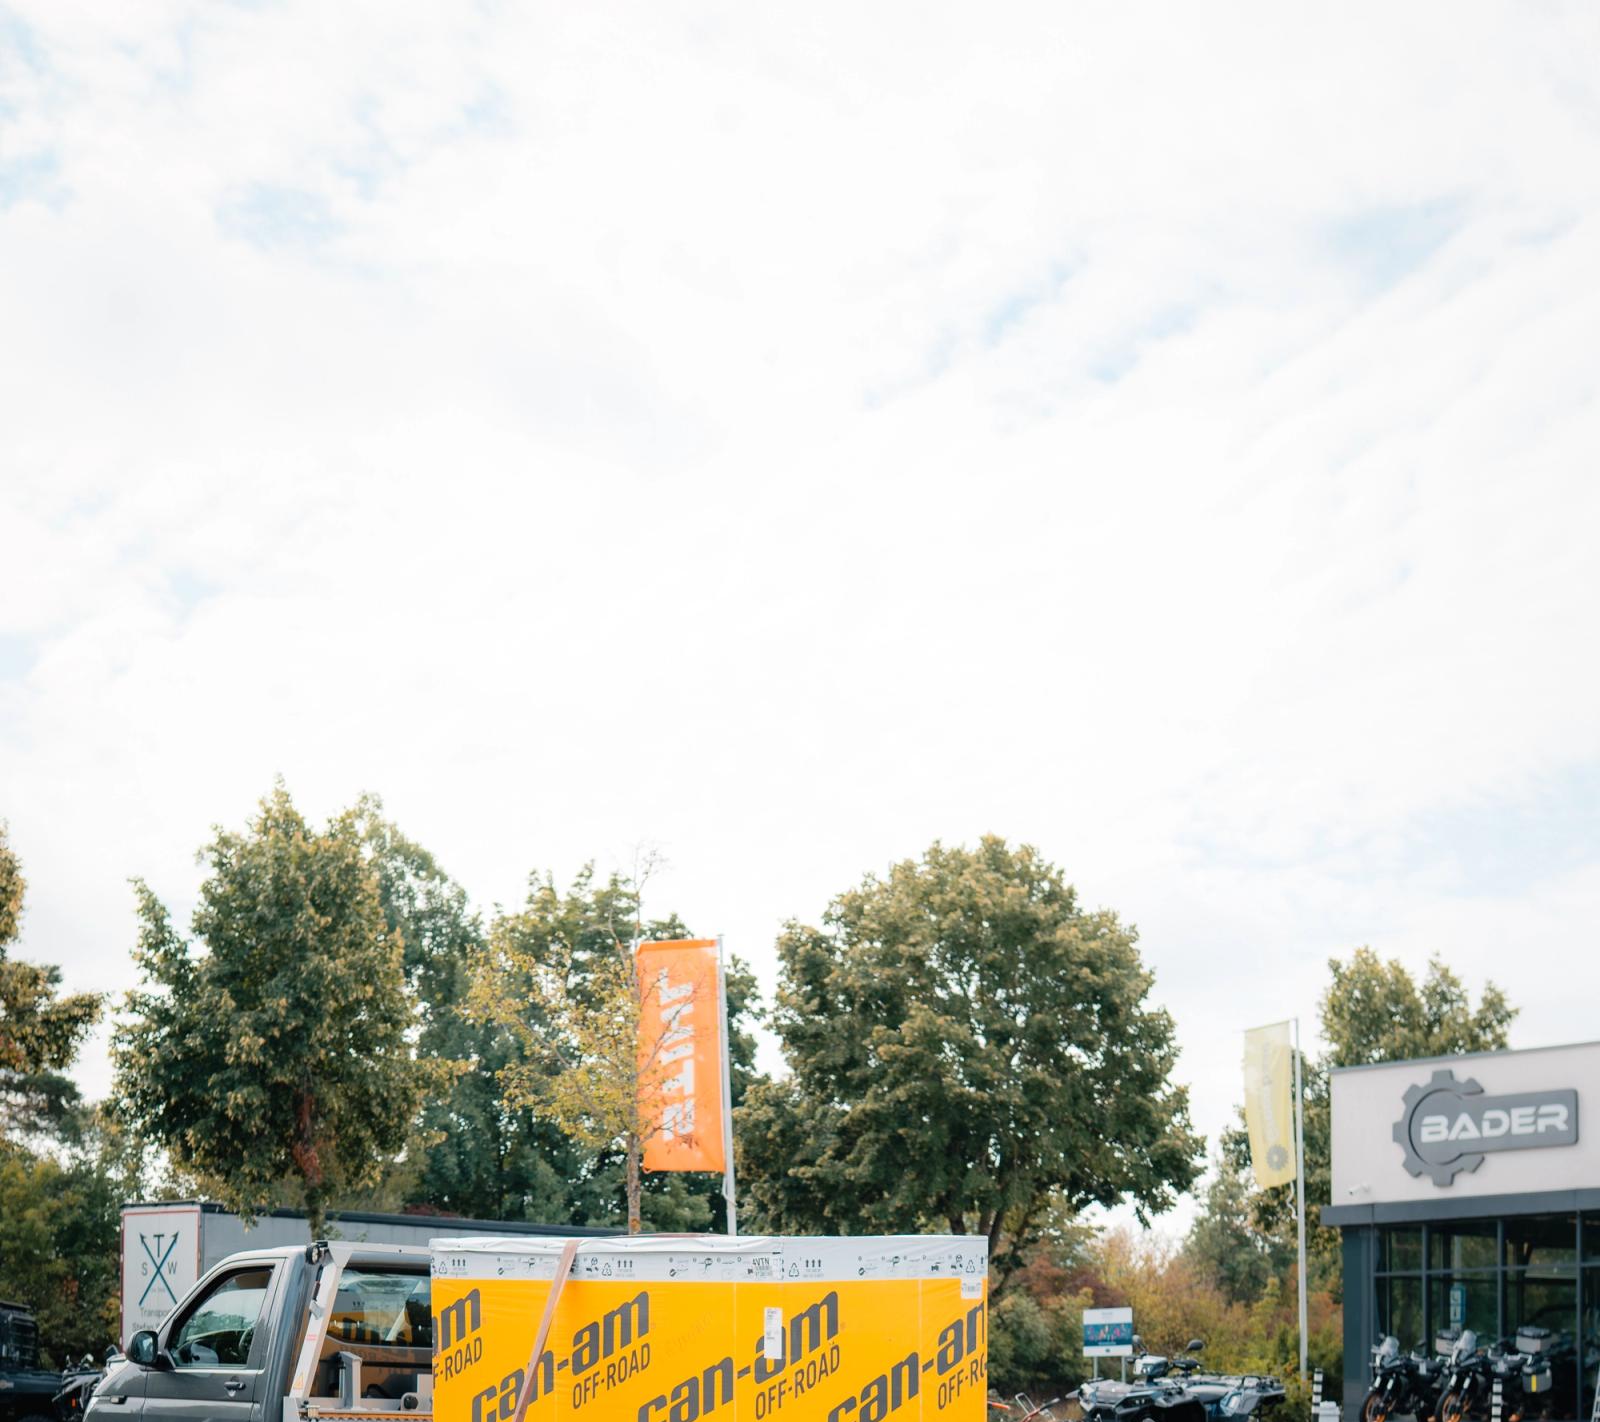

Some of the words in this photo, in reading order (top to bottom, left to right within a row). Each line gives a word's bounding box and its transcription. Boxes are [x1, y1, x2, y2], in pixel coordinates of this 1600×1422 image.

[1420, 1103, 1569, 1143] BADER
[573, 1342, 650, 1409] OFF-ROAD
[755, 1343, 840, 1421] OFF-ROAD
